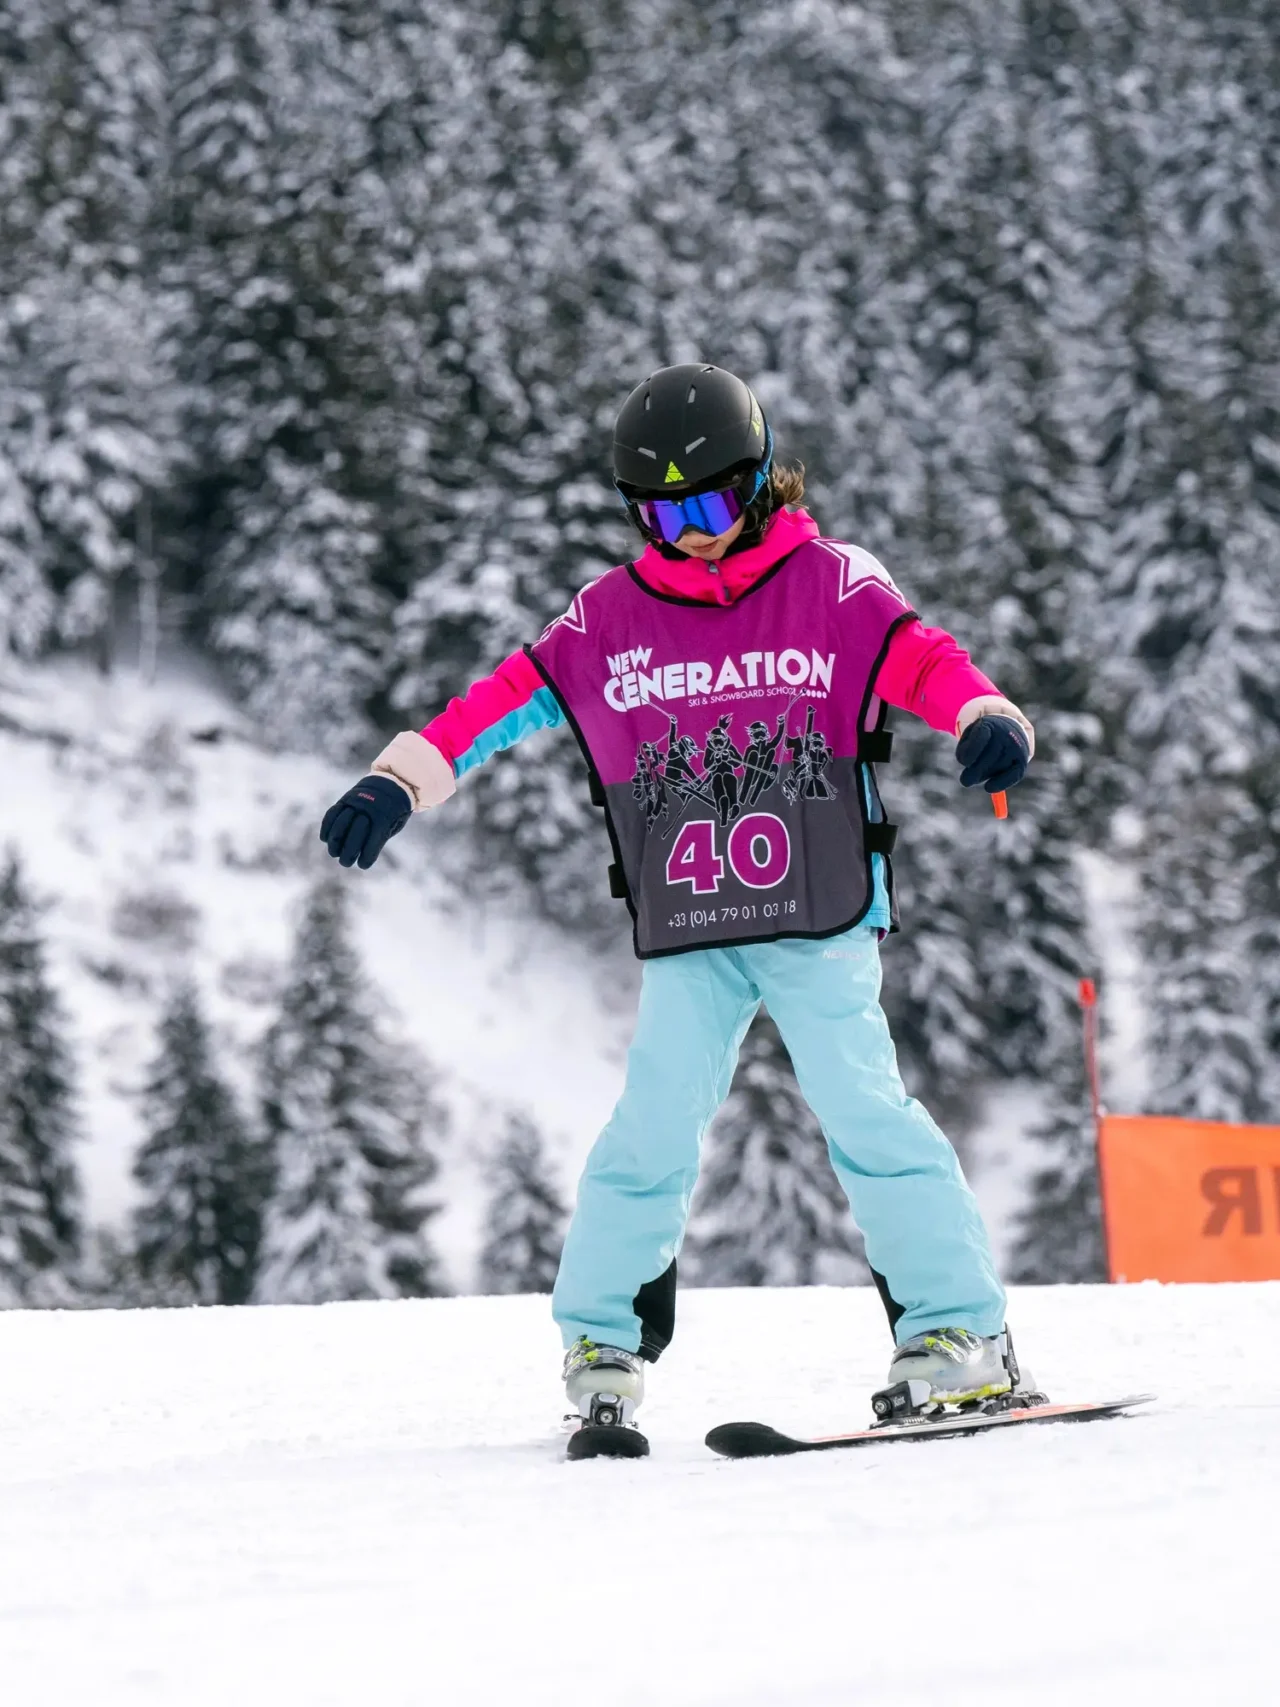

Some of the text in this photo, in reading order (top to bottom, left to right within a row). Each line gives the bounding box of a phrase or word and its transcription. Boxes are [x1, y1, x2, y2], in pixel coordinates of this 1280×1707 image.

[606, 644, 653, 676] NEW
[604, 648, 836, 712] GENERATION
[688, 686, 797, 708] SKI & SNOWBOARD SCHOOL
[666, 812, 791, 895] 40
[667, 900, 797, 928] +33 (0)4 79 01 03 18
